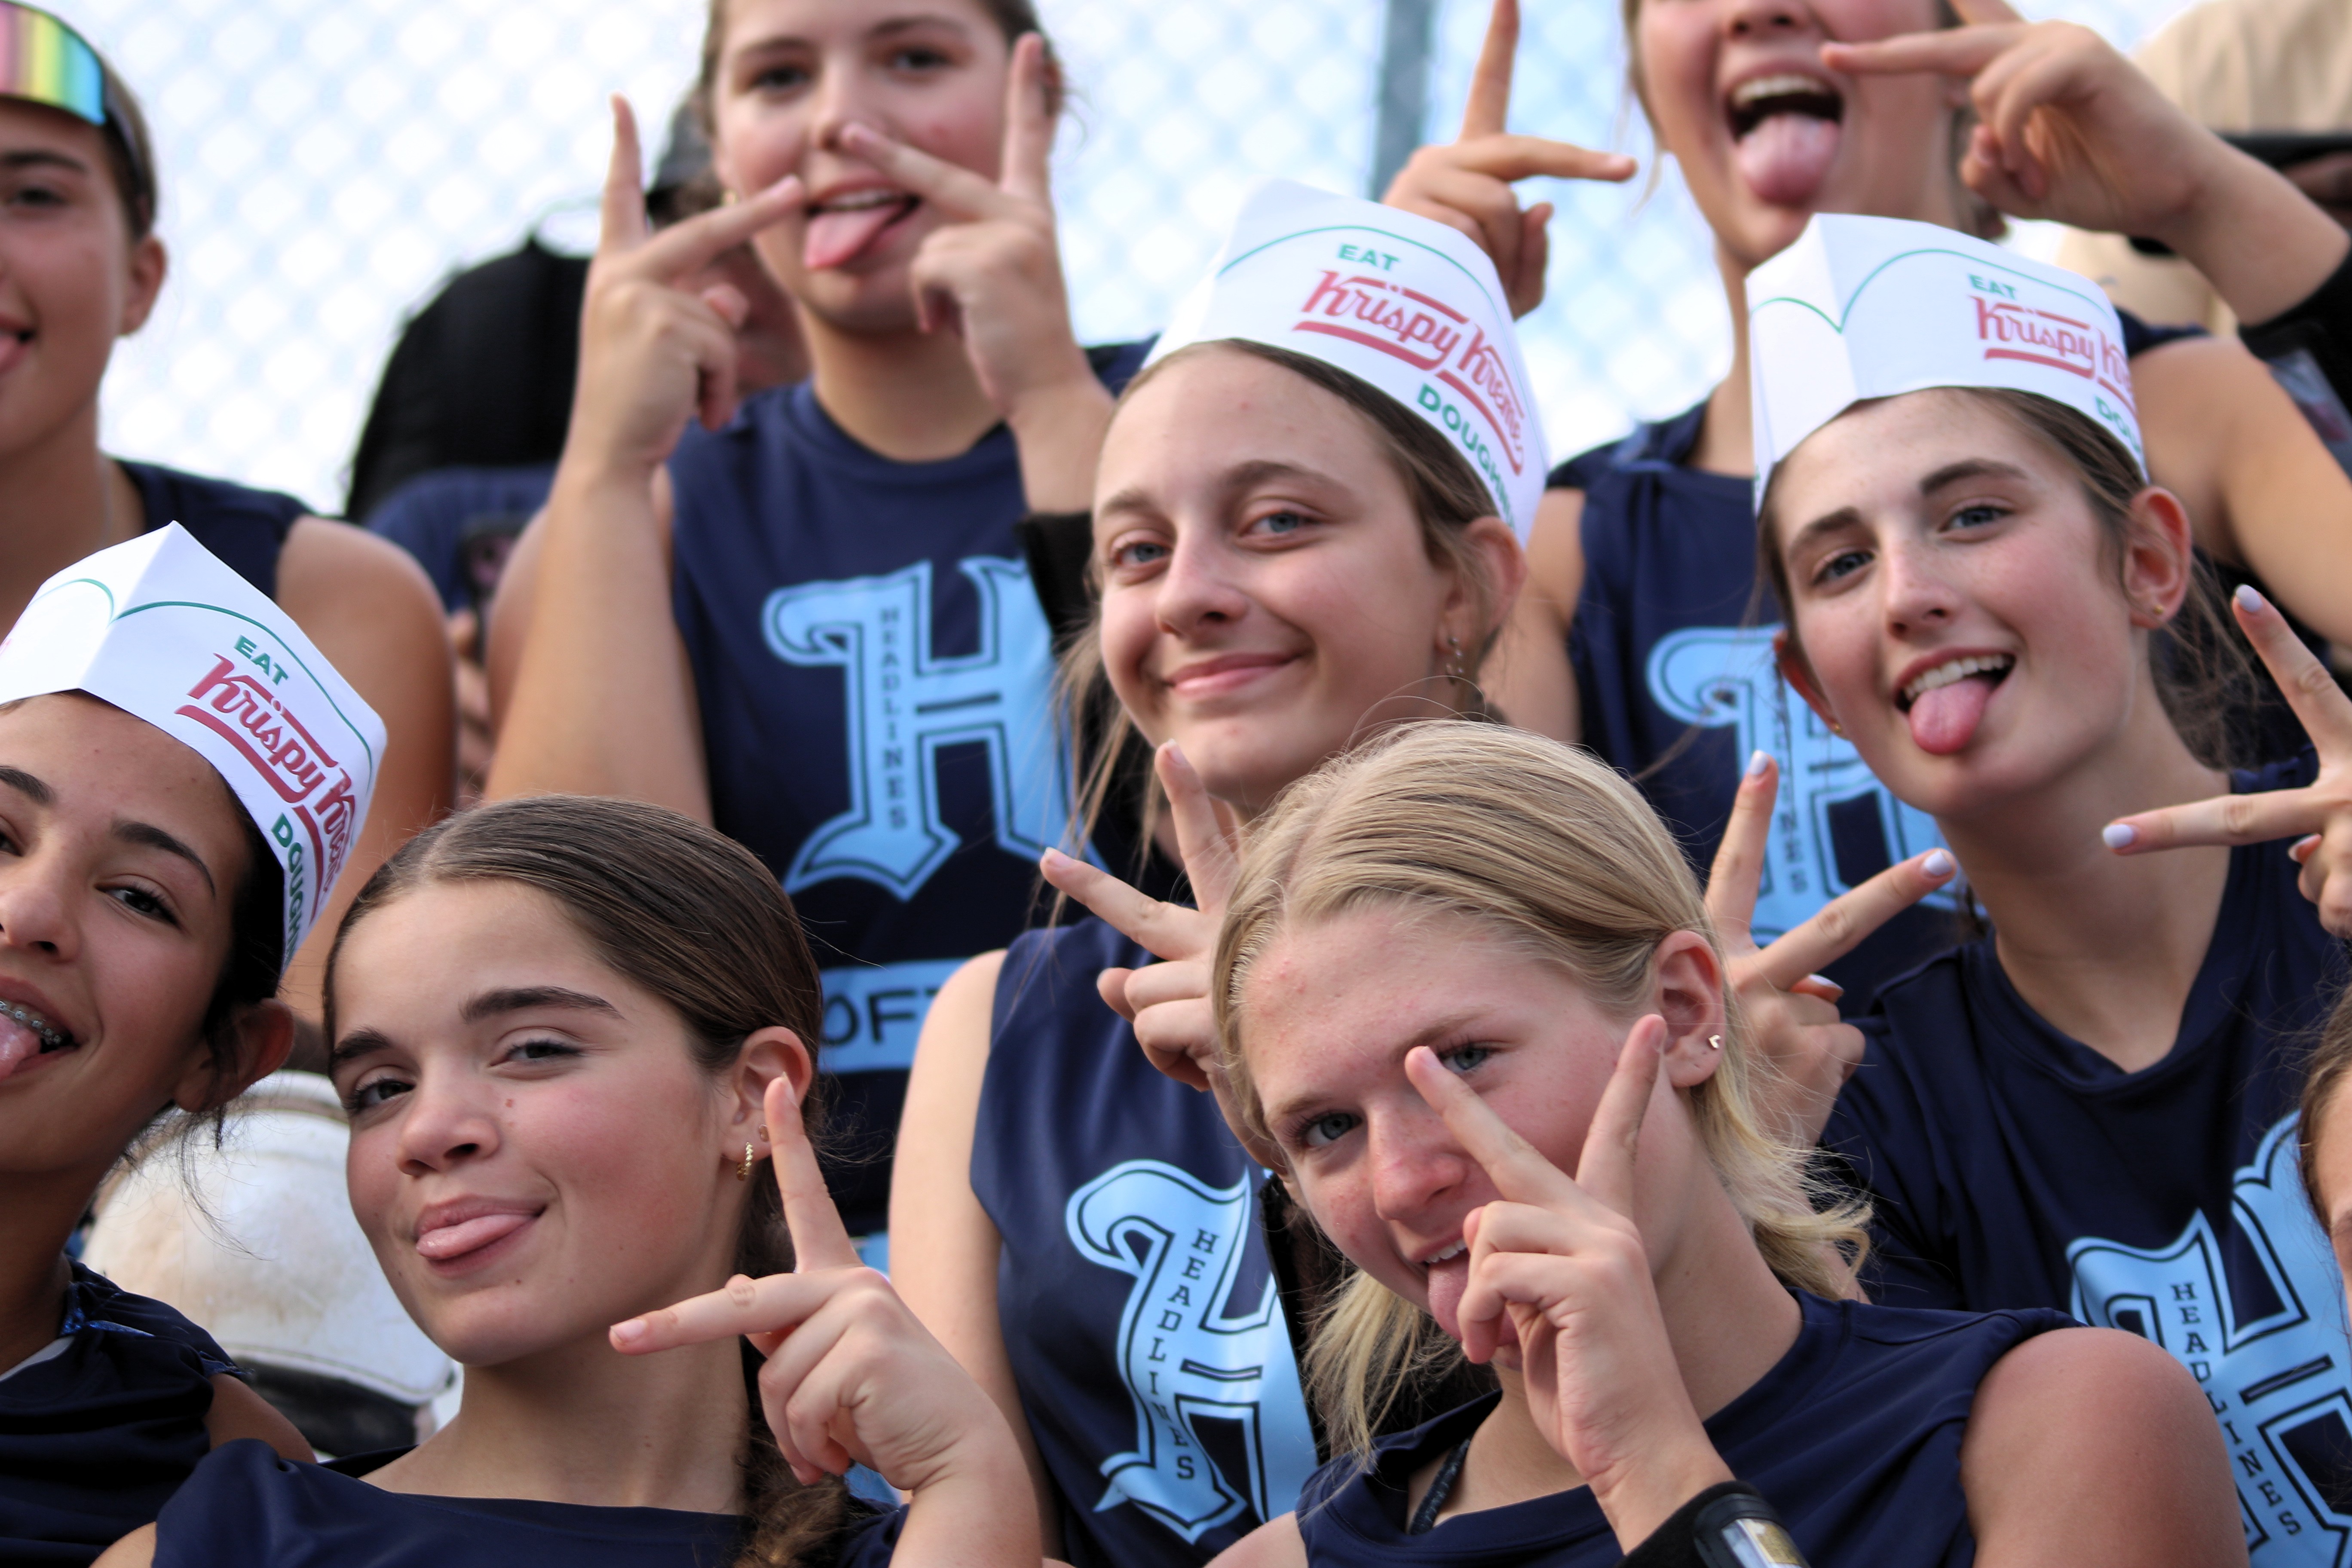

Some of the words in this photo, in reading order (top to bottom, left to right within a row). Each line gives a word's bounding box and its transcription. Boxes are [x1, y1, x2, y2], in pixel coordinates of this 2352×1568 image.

[1337, 244, 1400, 272] EAT
[1968, 273, 2016, 300] EAT
[1291, 269, 1470, 371] Krispy
[1967, 294, 2096, 380] Krispy
[233, 634, 289, 686] EAT
[174, 652, 340, 804] Krispy
[879, 607, 907, 830] HEADLINES
[1147, 1227, 1220, 1481] HEADLINES
